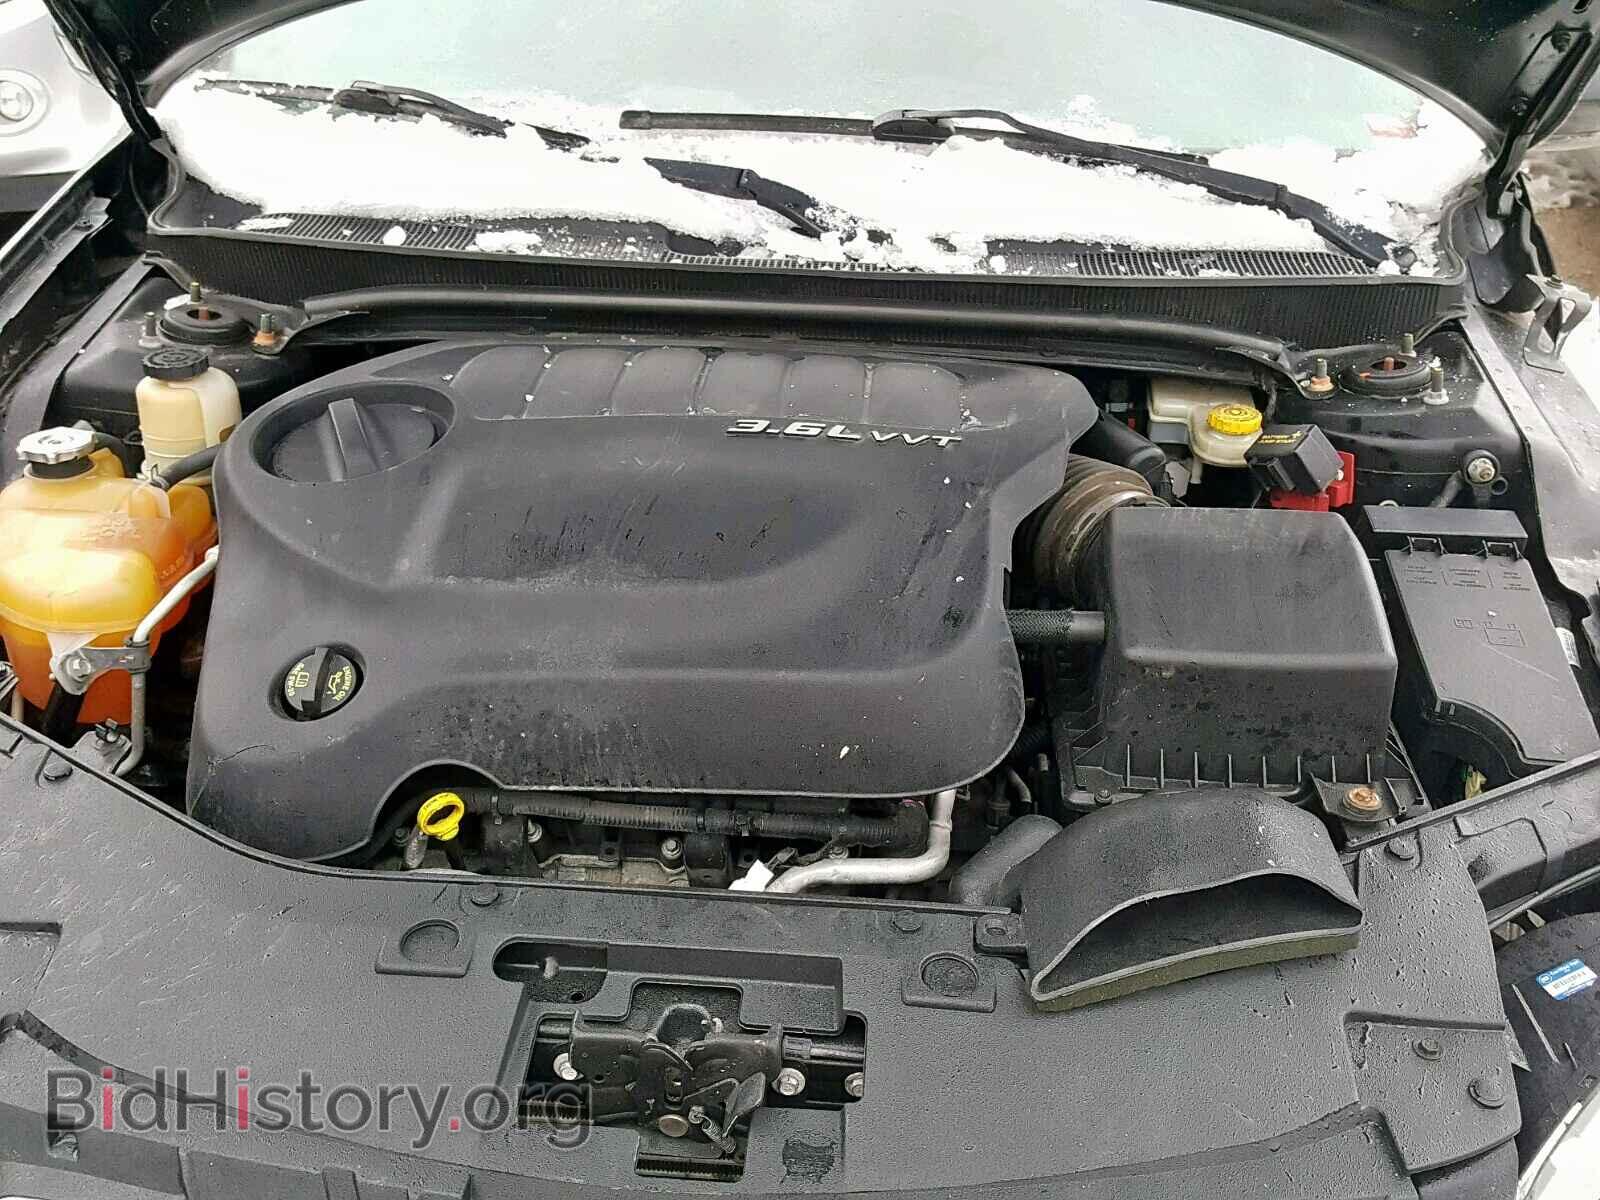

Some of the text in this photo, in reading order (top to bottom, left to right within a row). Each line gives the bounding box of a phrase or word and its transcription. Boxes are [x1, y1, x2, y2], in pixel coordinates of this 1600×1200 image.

[726, 419, 962, 447] 3.6L VVT
[331, 665, 353, 702] ENGINE OIL
